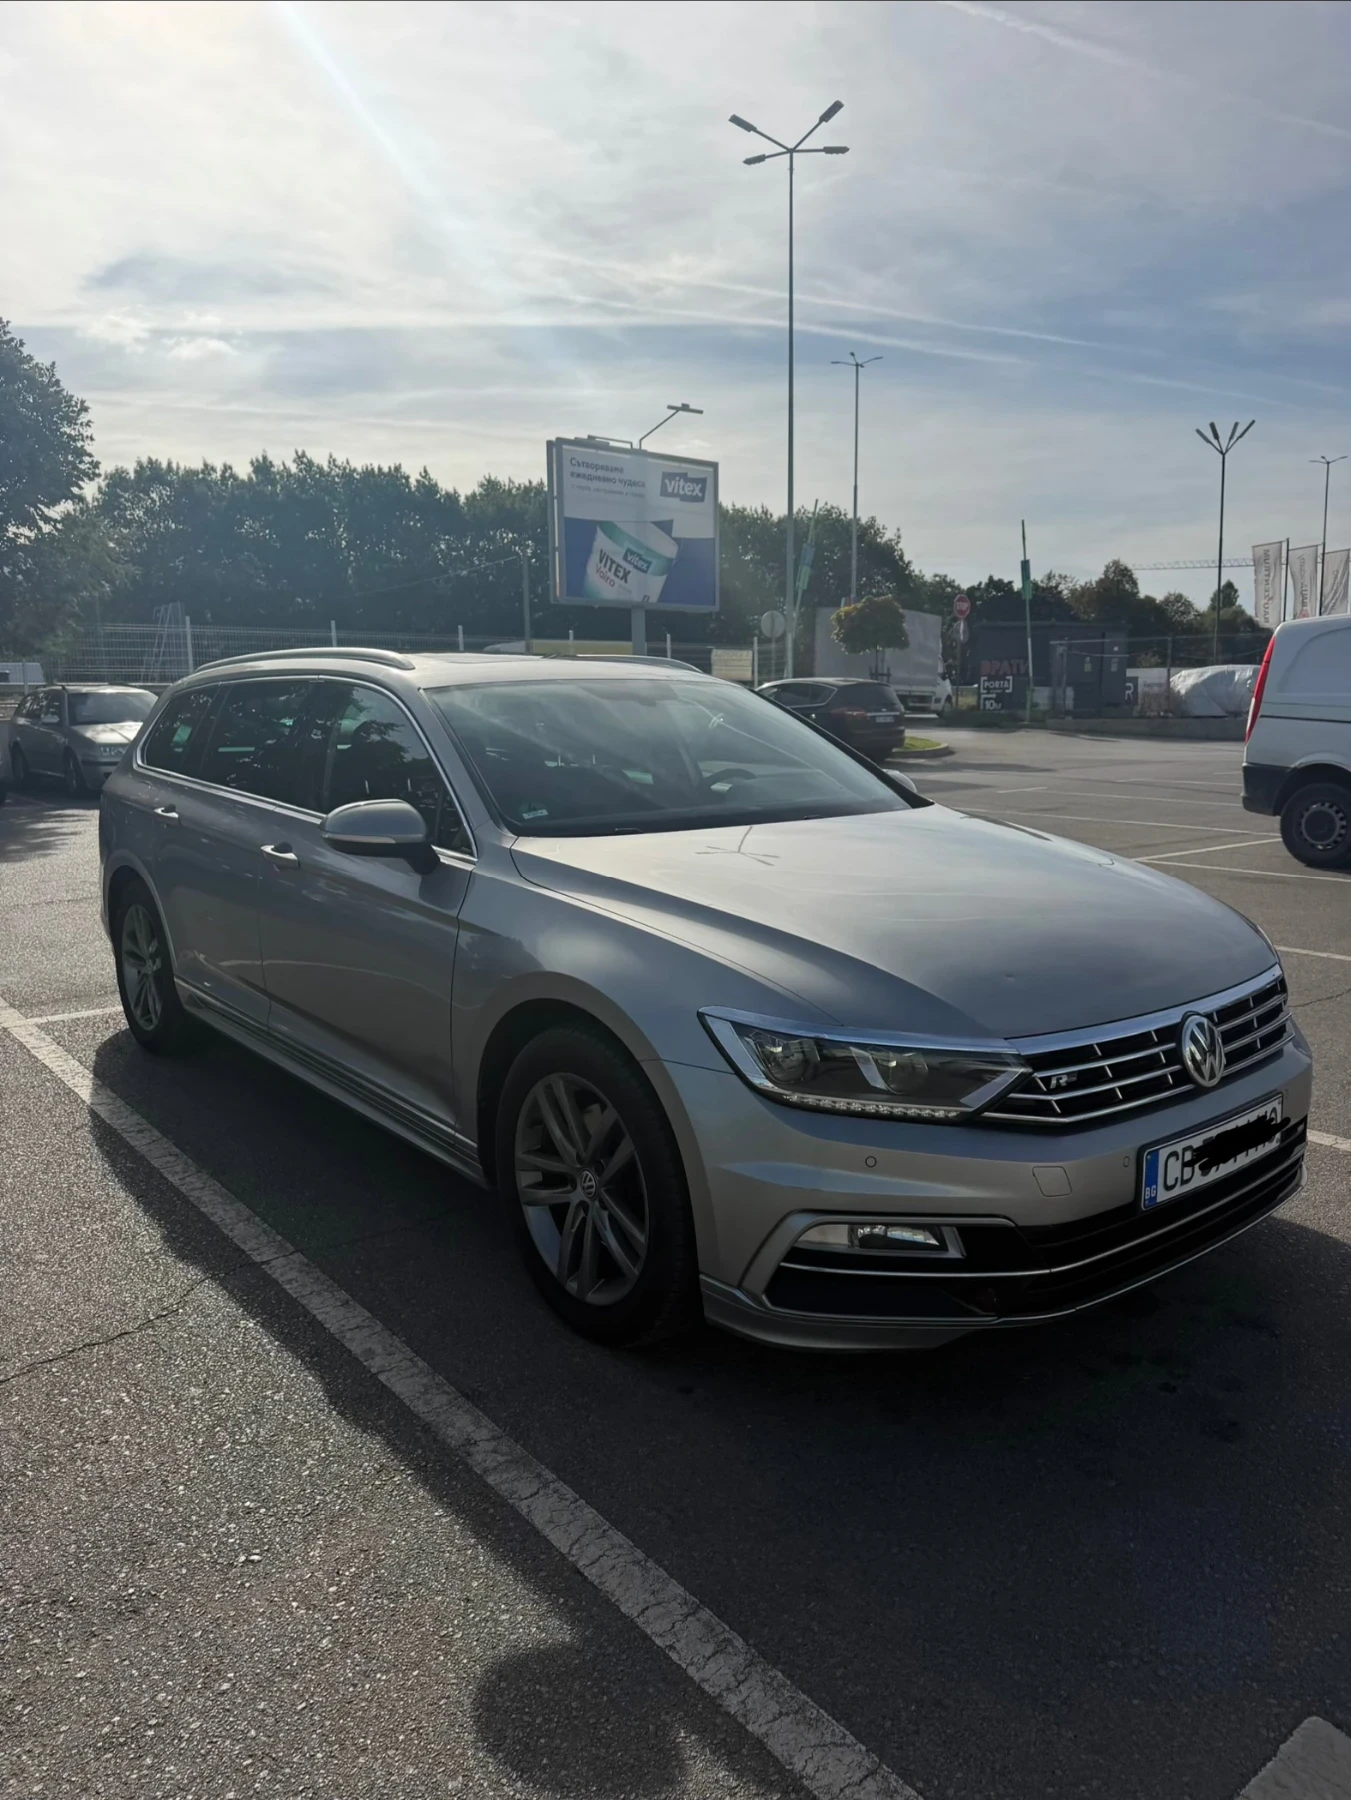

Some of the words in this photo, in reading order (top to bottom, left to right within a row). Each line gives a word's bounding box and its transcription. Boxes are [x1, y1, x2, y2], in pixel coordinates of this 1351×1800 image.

[570, 457, 624, 474] Сътворяваме
[618, 478, 646, 489] чудеса
[664, 477, 703, 497] vitex
[599, 549, 631, 584] VITEX
[626, 551, 649, 571] vitex
[1145, 1184, 1157, 1200] BG
